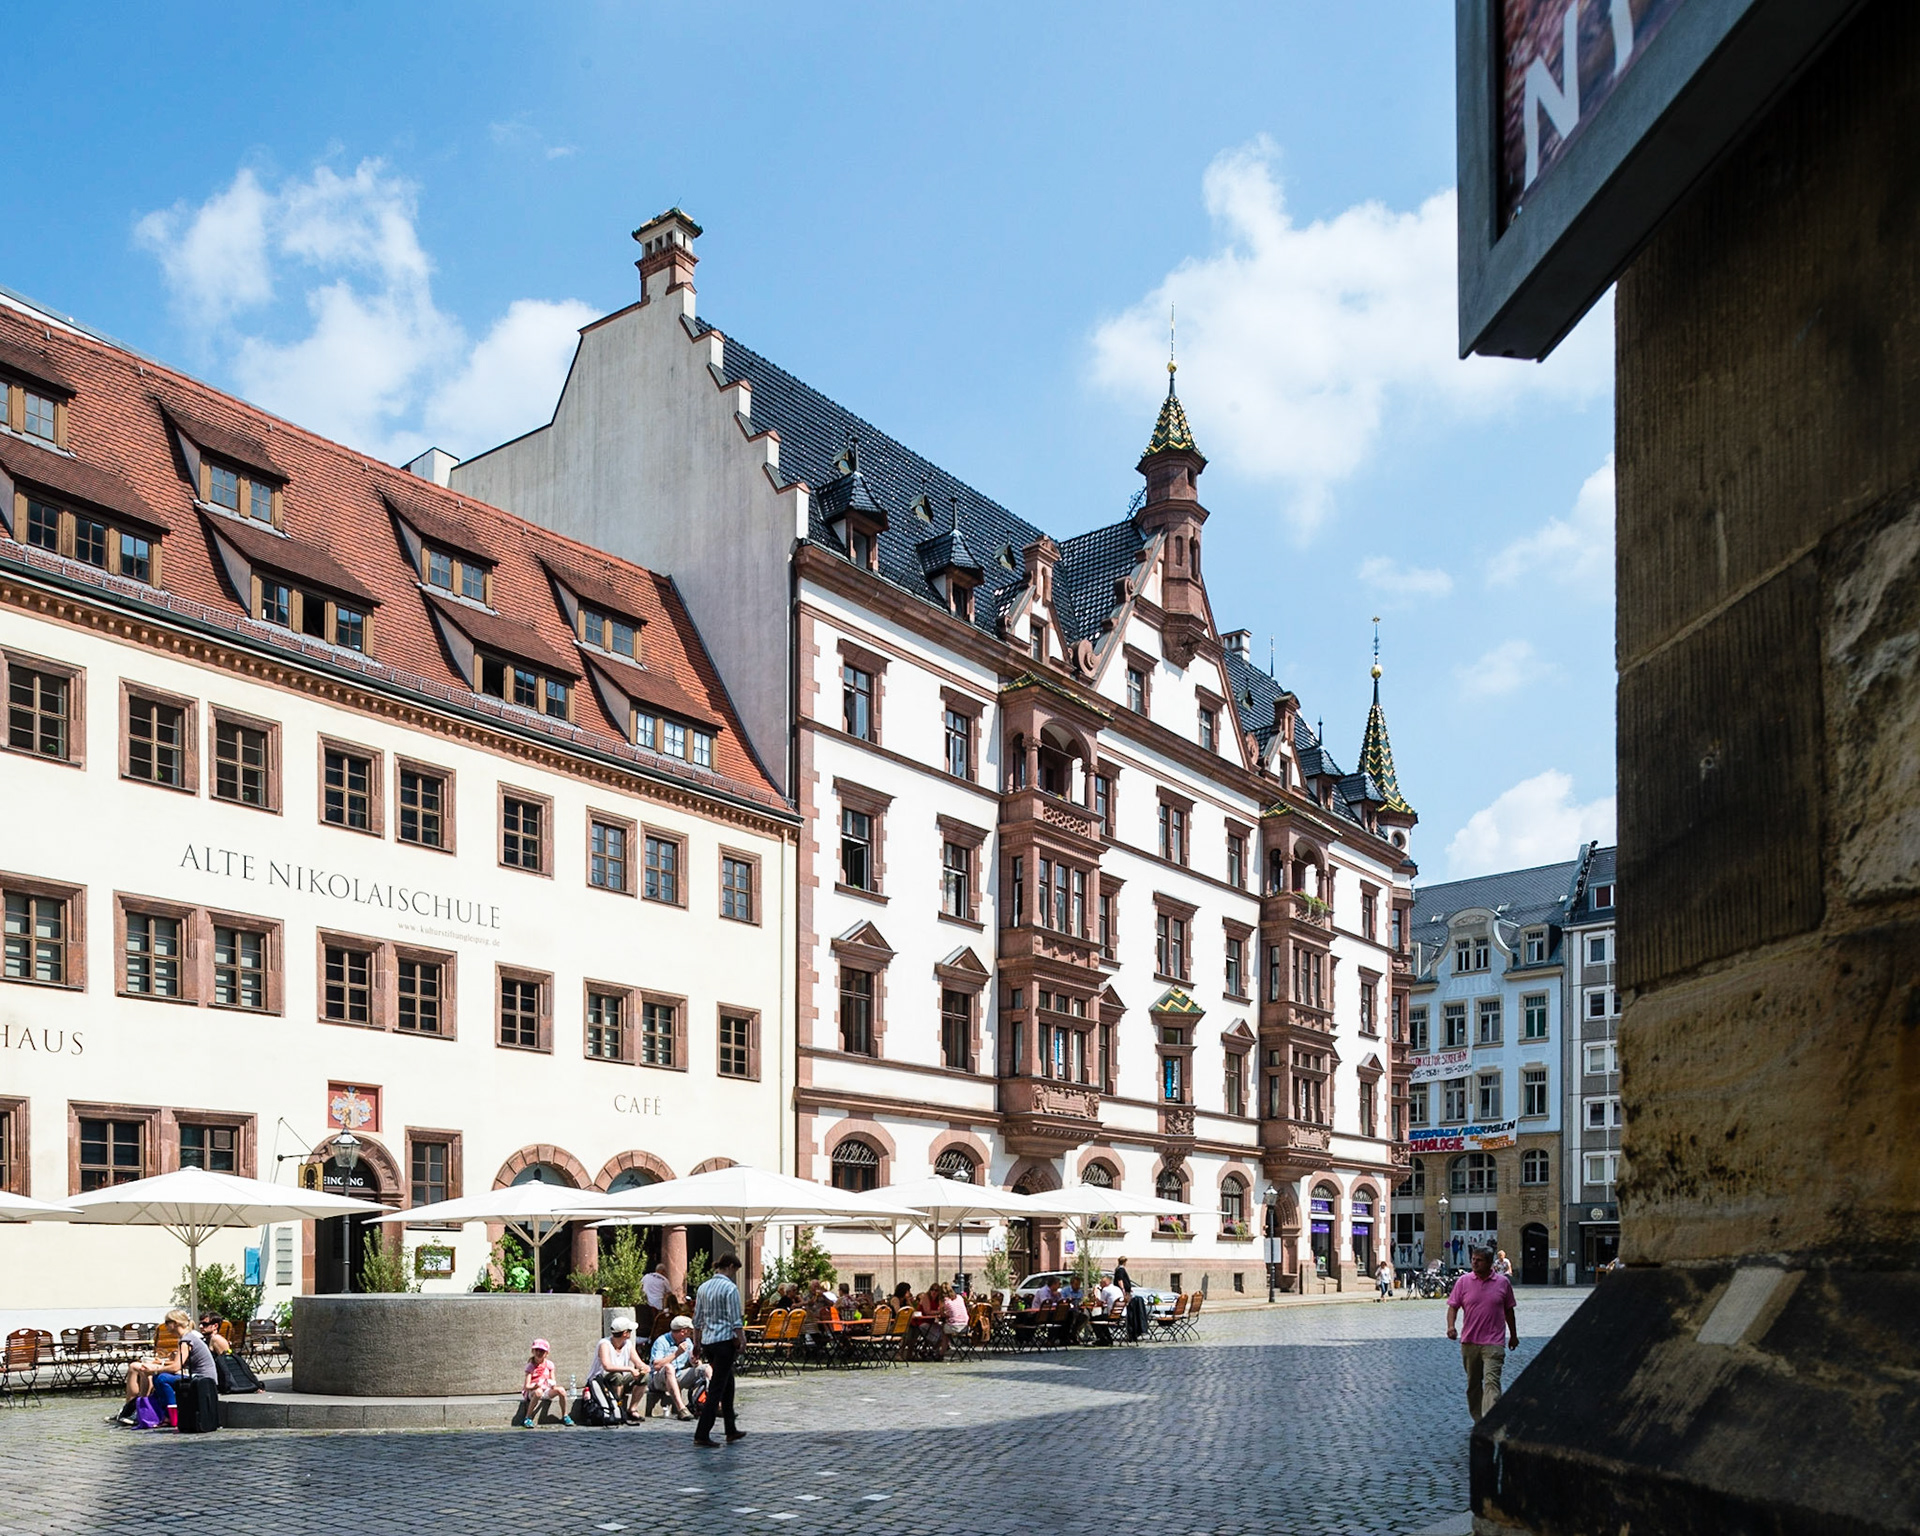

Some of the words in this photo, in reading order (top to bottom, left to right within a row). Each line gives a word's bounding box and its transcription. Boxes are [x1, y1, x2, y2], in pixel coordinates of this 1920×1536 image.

[179, 843, 255, 881] ALTE
[268, 859, 500, 929] NIKOLAISCHULE
[614, 1094, 661, 1116] CAFÉ
[323, 1175, 364, 1187] EINGNG
